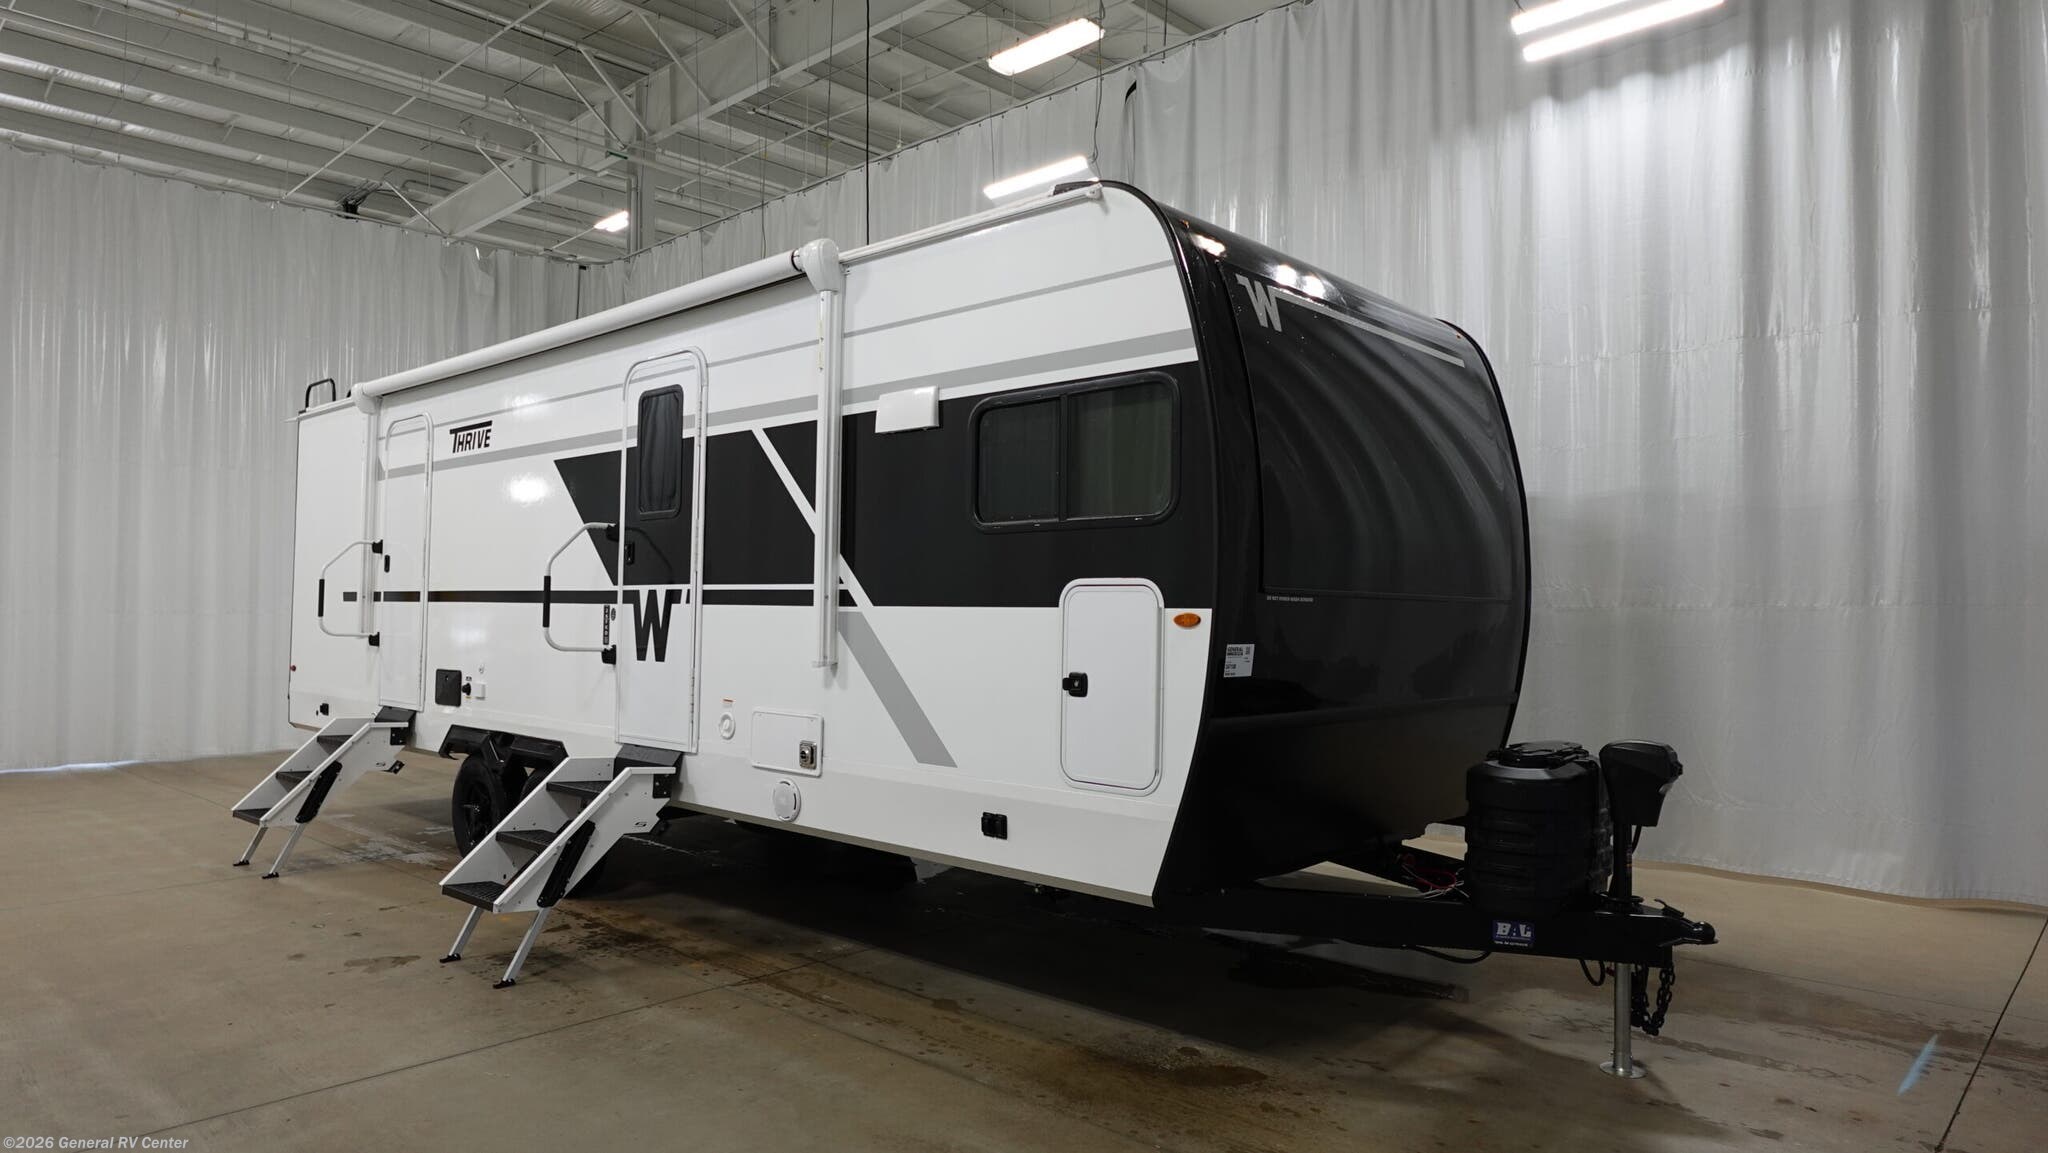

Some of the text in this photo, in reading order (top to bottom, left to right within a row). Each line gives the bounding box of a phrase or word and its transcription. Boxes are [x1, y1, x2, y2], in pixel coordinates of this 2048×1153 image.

[1235, 273, 1283, 332] W
[449, 420, 492, 453] THRIVE
[626, 588, 680, 662] W
